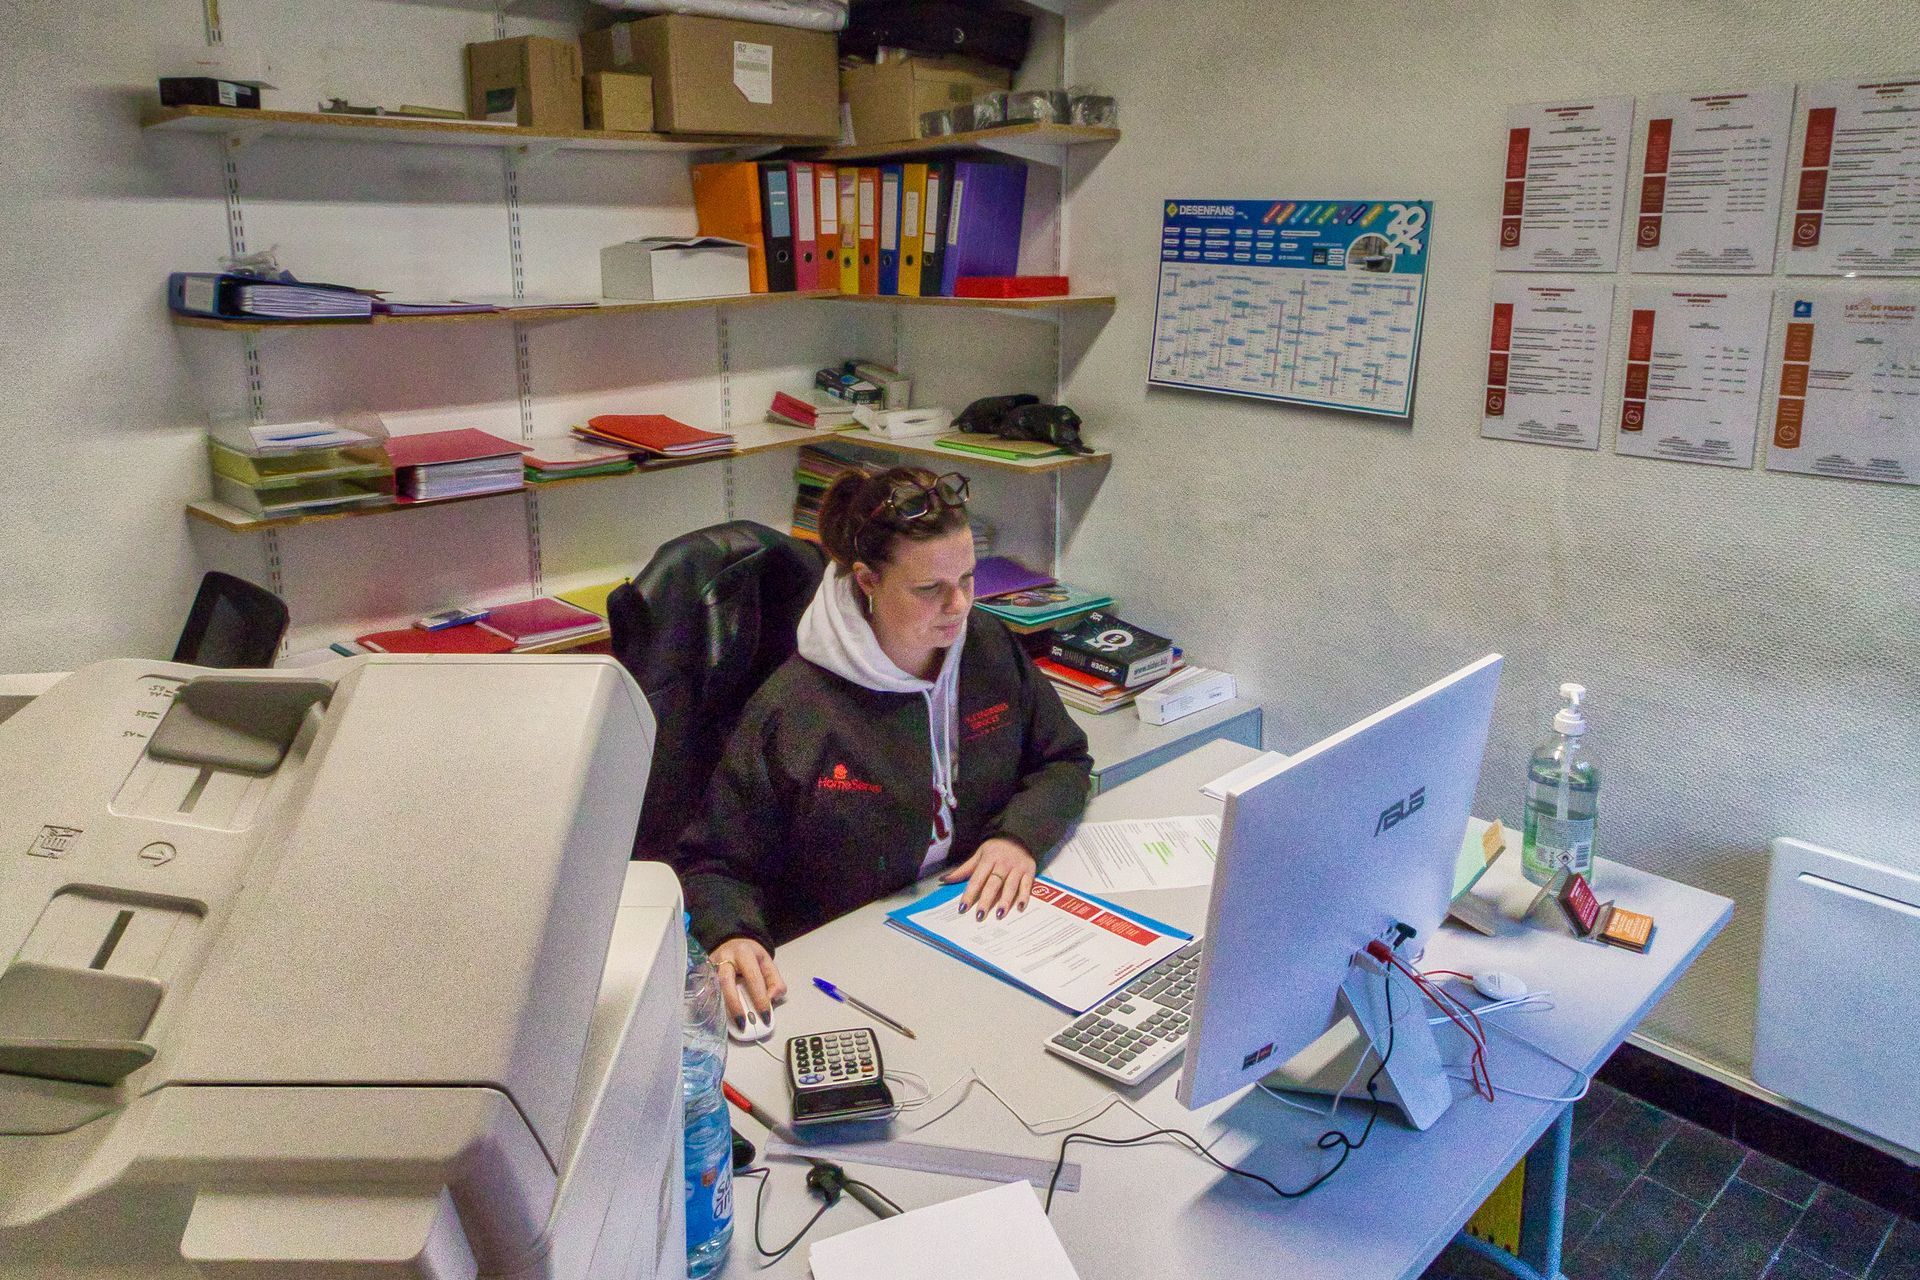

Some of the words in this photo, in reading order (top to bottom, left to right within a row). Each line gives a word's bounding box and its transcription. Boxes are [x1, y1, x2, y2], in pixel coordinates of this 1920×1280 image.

[1179, 205, 1235, 216] DESENFANS
[1091, 661, 1109, 672] SIDER
[1373, 786, 1426, 838] ASUS
